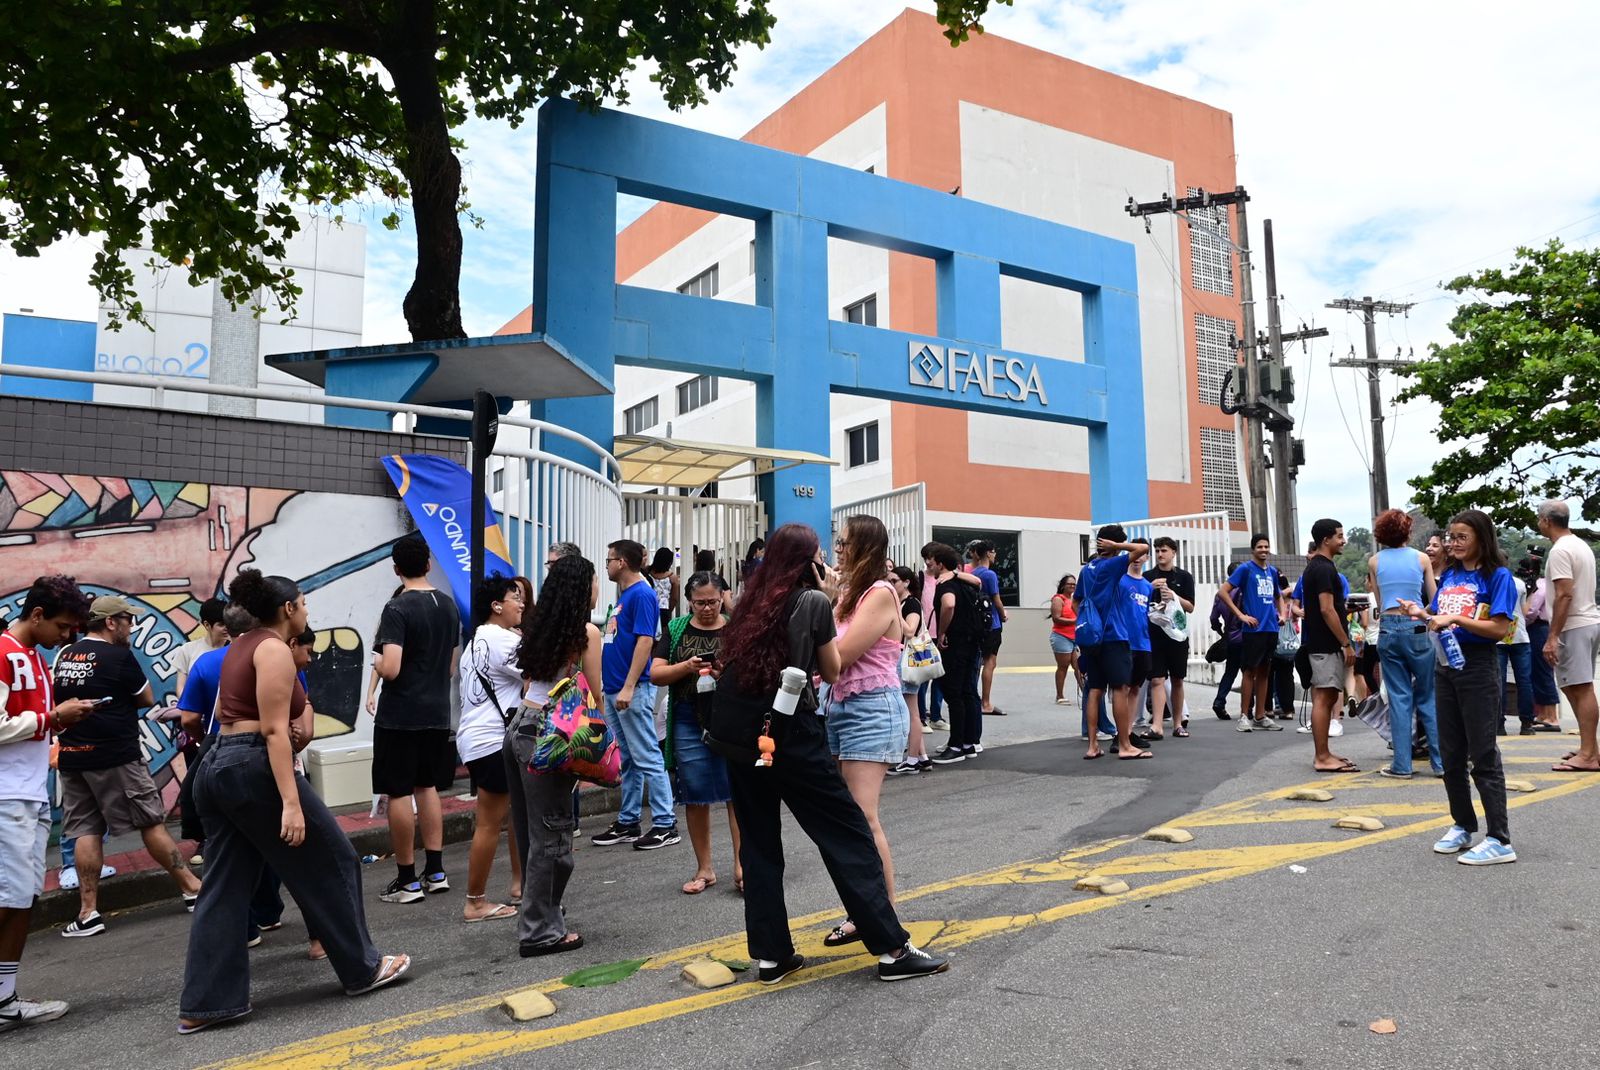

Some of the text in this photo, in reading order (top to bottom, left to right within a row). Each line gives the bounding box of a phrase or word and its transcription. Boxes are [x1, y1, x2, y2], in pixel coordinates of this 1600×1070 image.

[184, 342, 209, 377] 2
[947, 347, 1048, 405] FAESA
[793, 484, 815, 498] 199
[439, 506, 471, 571] MUNDO
[1437, 592, 1475, 608] PAEBES
[73, 653, 87, 661] AM
[7, 652, 37, 692] R
[57, 670, 87, 679] MUNDO
